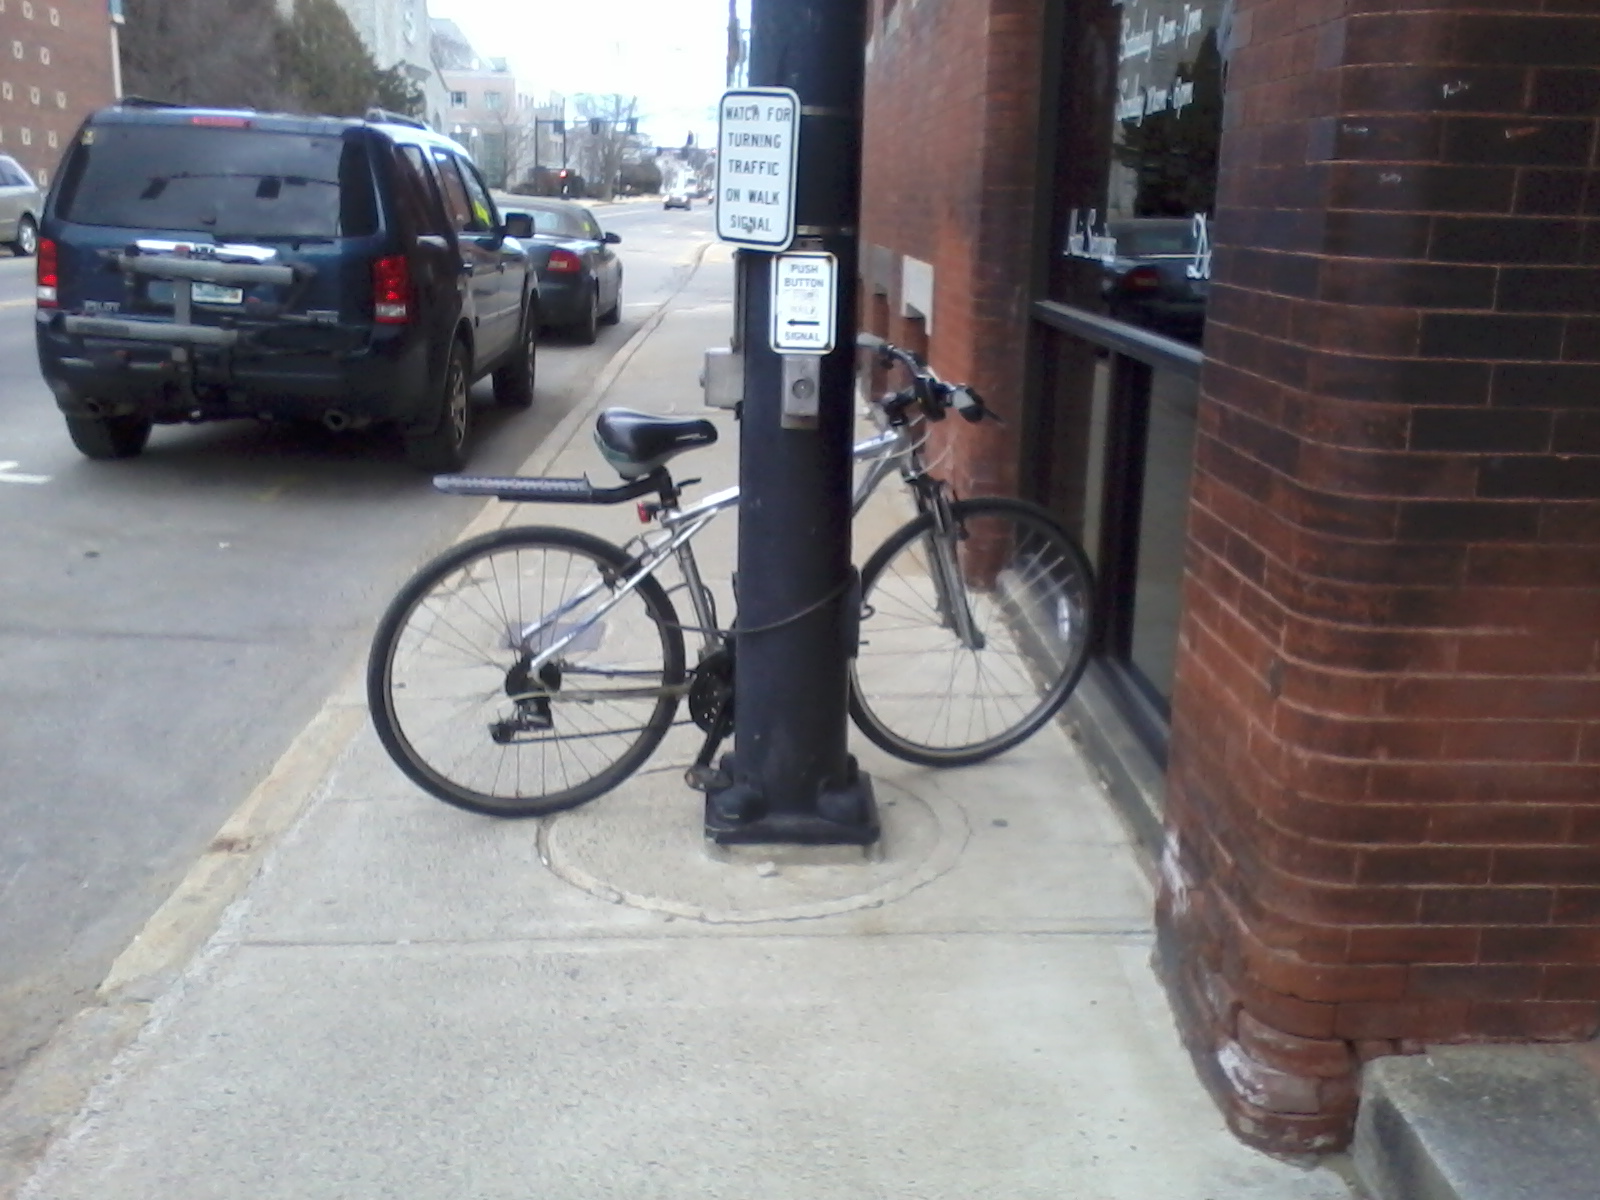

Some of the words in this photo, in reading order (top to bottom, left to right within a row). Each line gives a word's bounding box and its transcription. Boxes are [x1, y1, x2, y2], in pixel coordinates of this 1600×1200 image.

[726, 106, 759, 121] WATCH
[767, 107, 791, 122] FOR
[728, 132, 782, 149] TURNING
[728, 159, 780, 176] TRAFFIC
[726, 188, 740, 202] ON
[748, 189, 780, 205] WALK
[730, 214, 772, 232] SIGNAL
[791, 264, 818, 273] PUSH
[784, 278, 824, 287] BUTTON
[785, 331, 820, 341] SIGNAL
